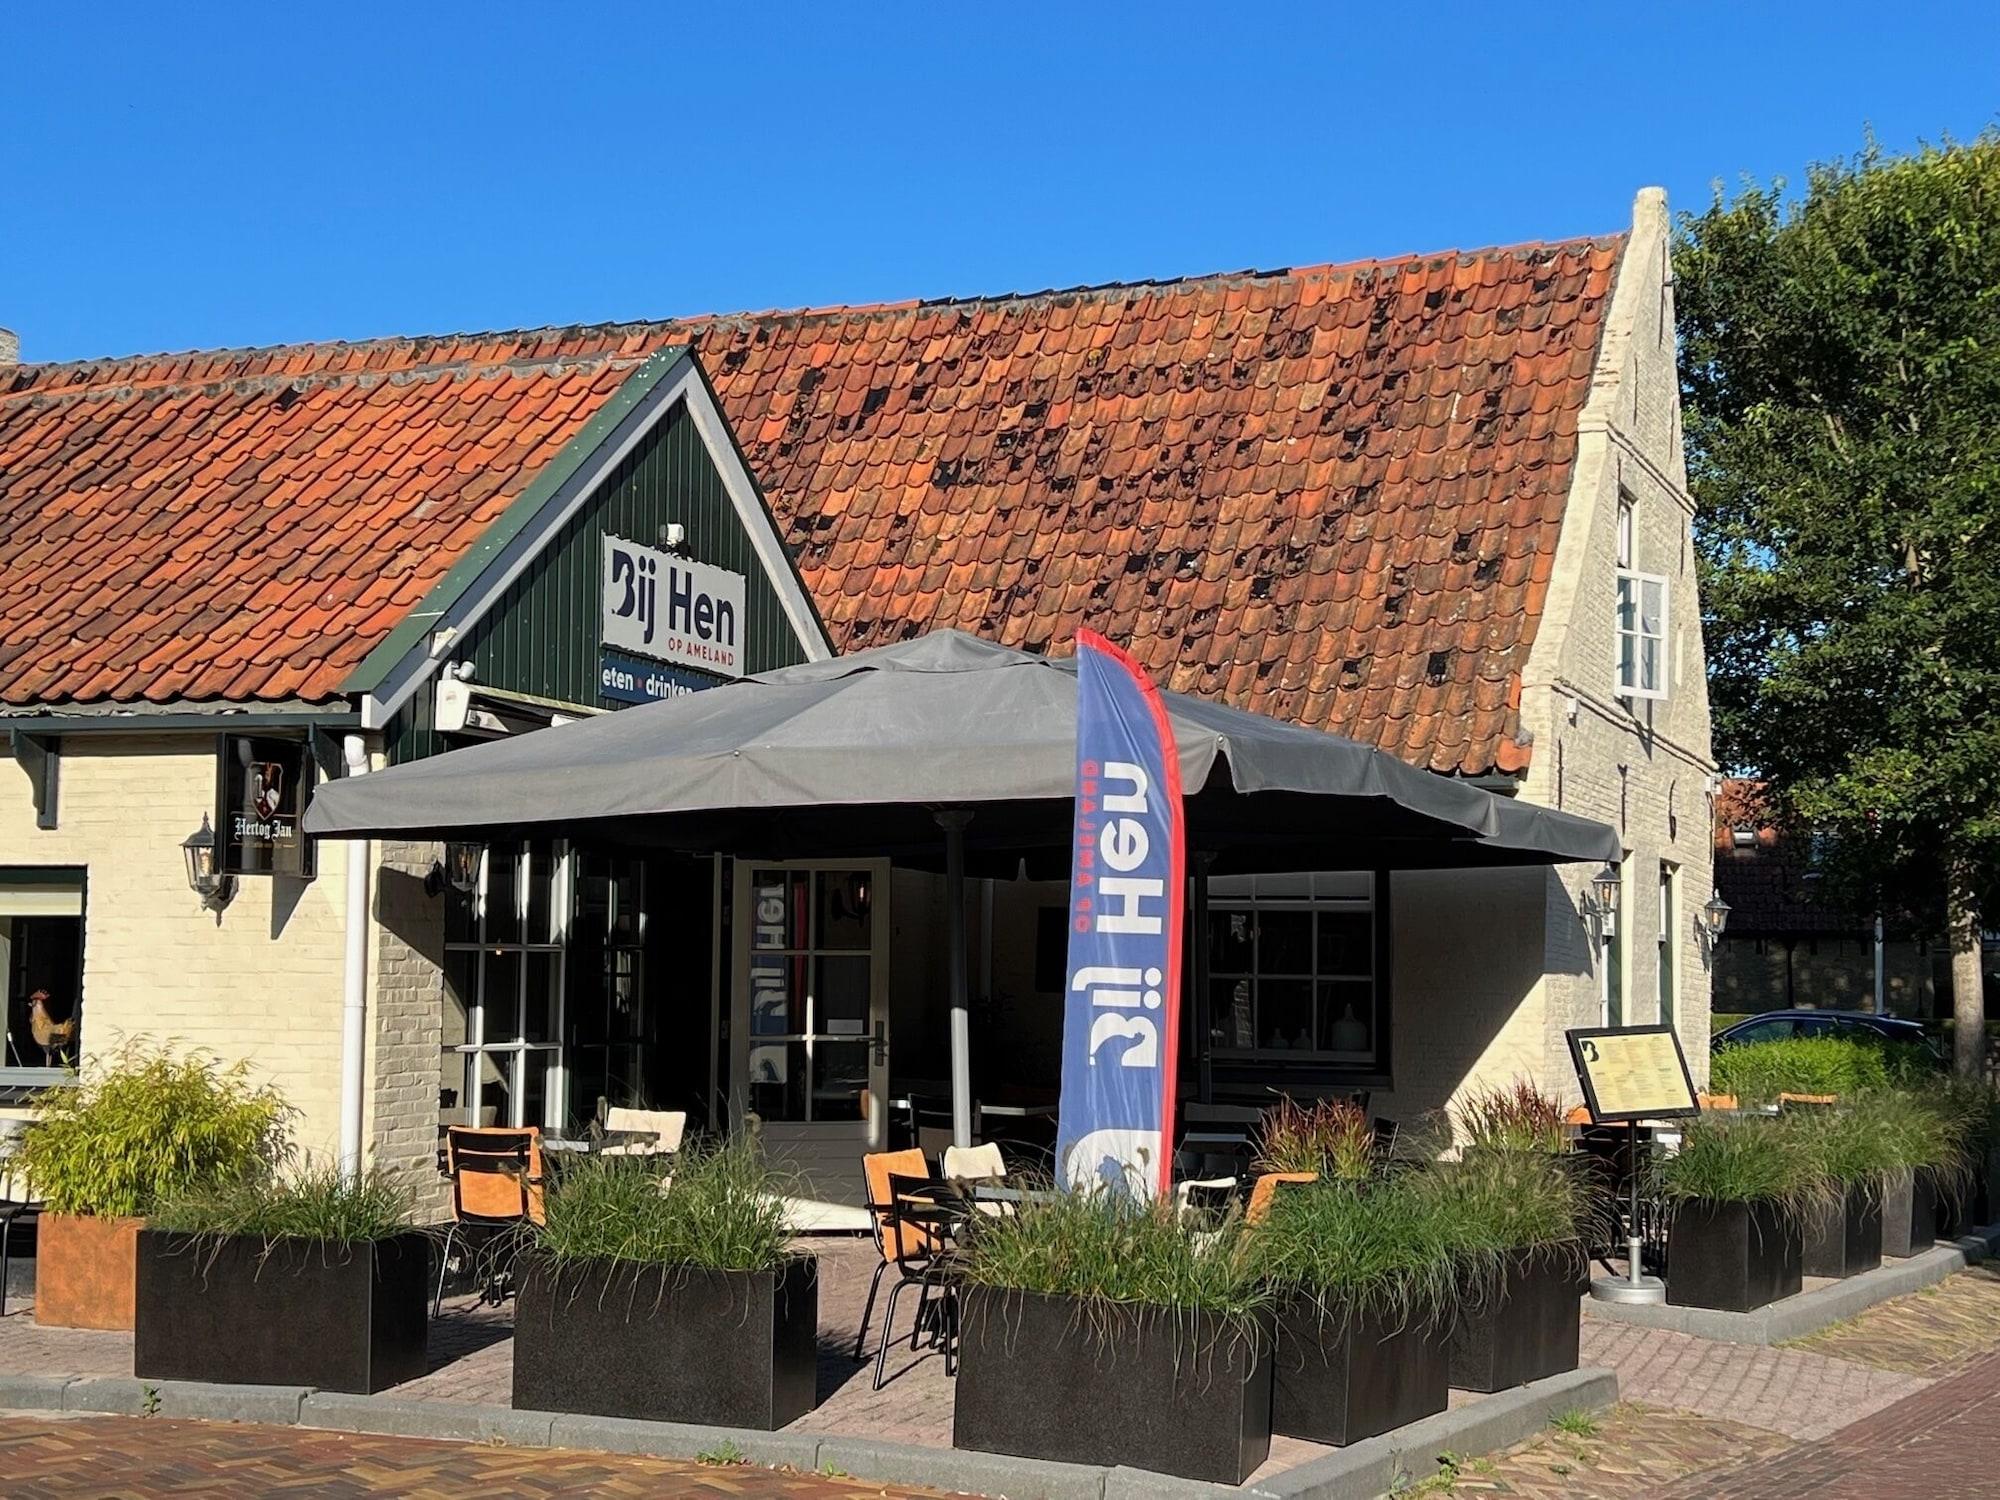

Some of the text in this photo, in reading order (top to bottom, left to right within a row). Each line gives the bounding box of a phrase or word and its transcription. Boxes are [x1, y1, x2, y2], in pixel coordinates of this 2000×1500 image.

[612, 549, 734, 646] Bij Hen
[668, 637, 734, 666] OP AMELAND
[602, 667, 634, 691] eten
[234, 816, 292, 842] Hertog Jan
